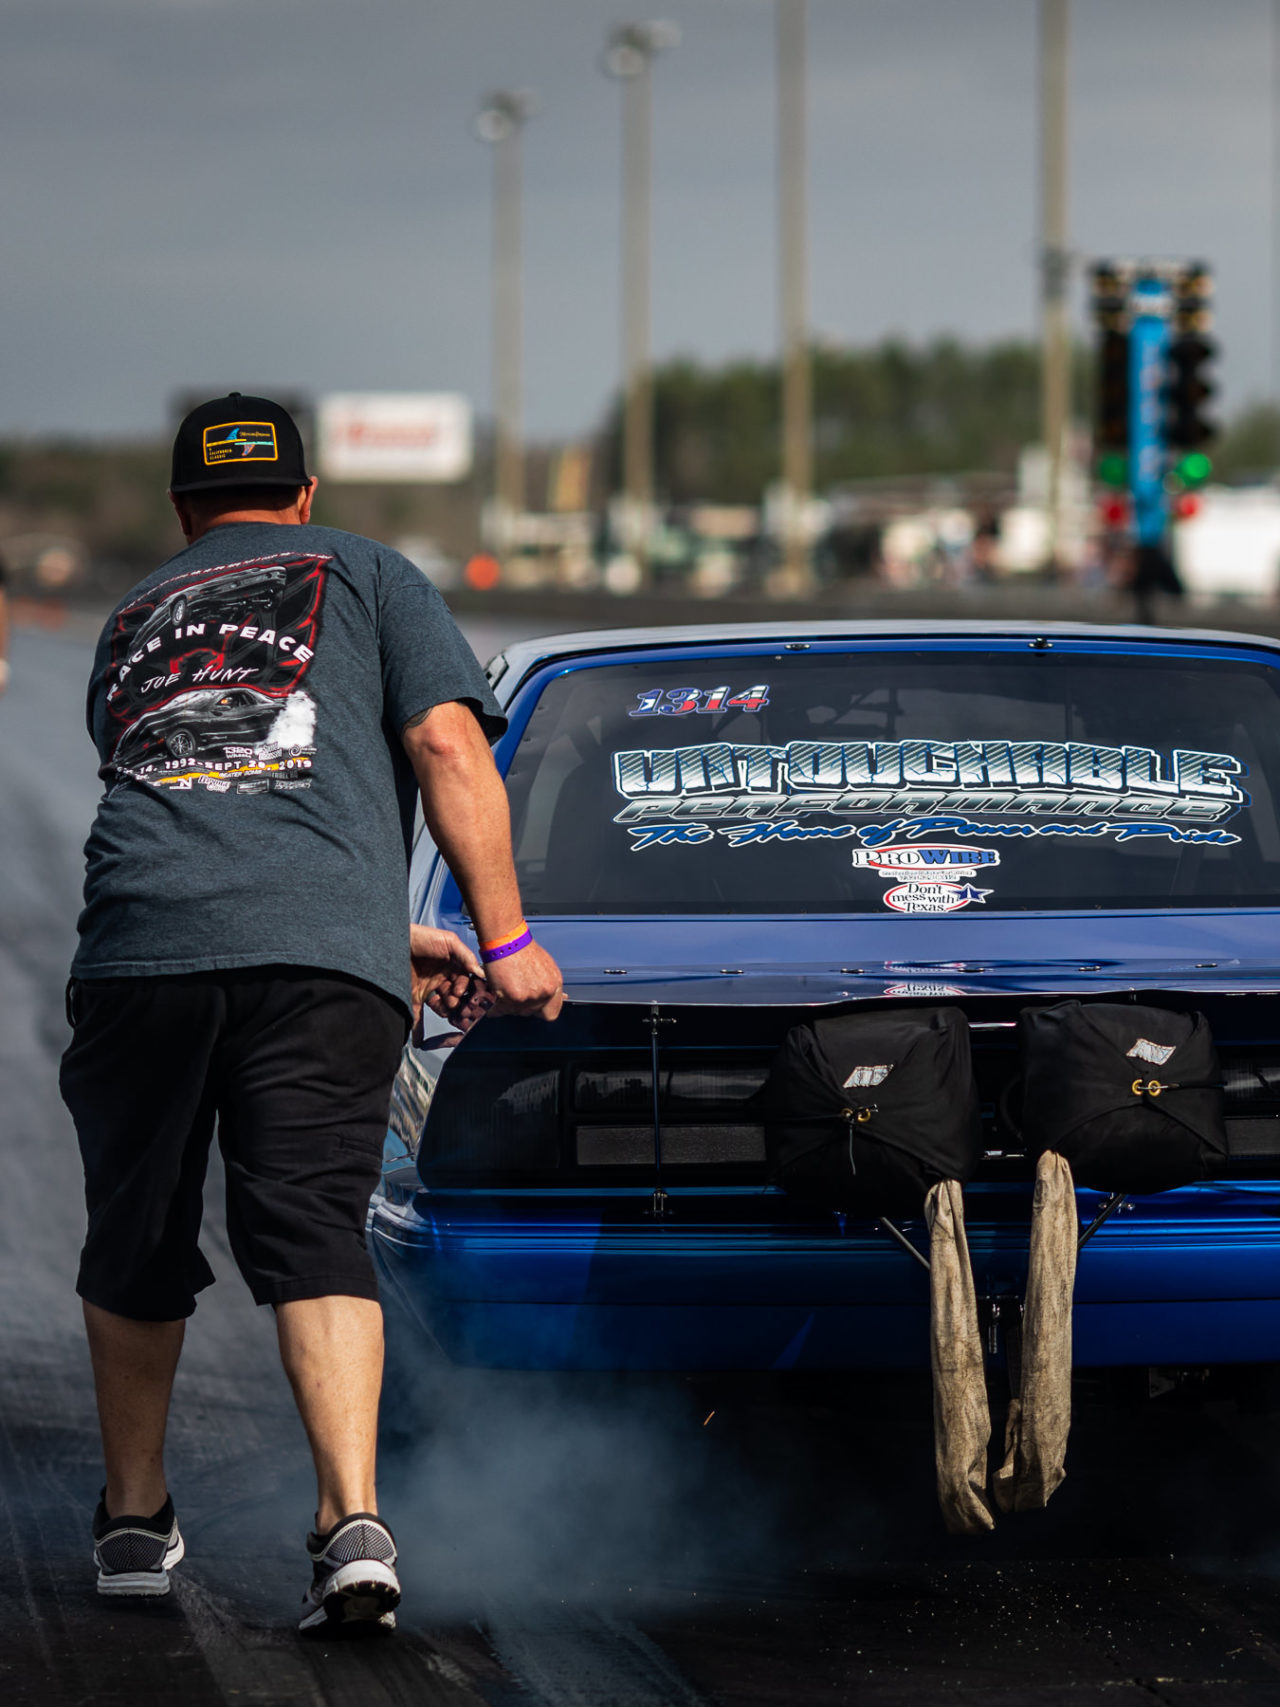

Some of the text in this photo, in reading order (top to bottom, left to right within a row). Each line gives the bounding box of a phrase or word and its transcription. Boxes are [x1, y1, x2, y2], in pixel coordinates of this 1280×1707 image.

[174, 623, 206, 640] IN
[218, 623, 315, 664] PEACE
[140, 664, 260, 694] JOE HUNT
[629, 685, 770, 716] 1314
[614, 740, 1244, 801] UNTOUCHABLE
[627, 816, 1242, 851] The Home of Power and Pride
[892, 894, 955, 904] mess with
[908, 883, 943, 895] Don't
